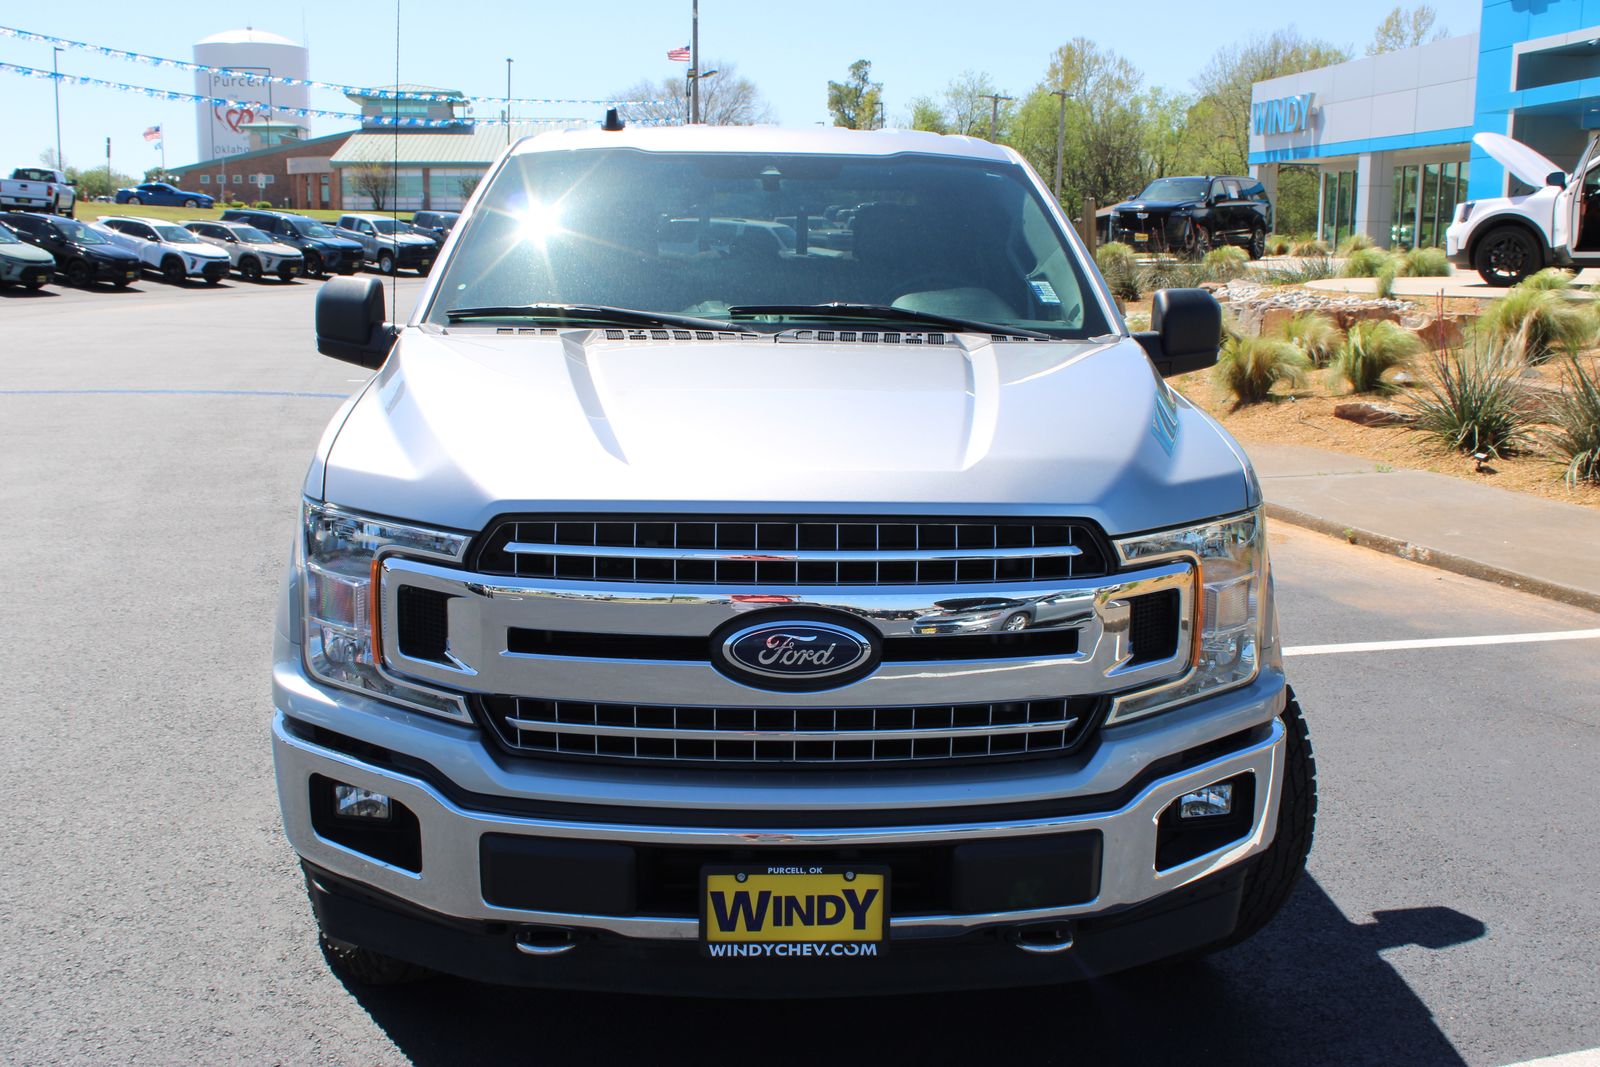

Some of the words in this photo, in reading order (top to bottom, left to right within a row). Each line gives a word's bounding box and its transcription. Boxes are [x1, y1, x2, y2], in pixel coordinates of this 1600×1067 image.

[1252, 92, 1316, 136] WINDY
[214, 144, 250, 154] Oklaho
[758, 633, 836, 665] Ford
[767, 867, 807, 875] PURCELL,
[709, 888, 880, 932] WINDY
[708, 943, 878, 957] WINDYCHEV.COM
